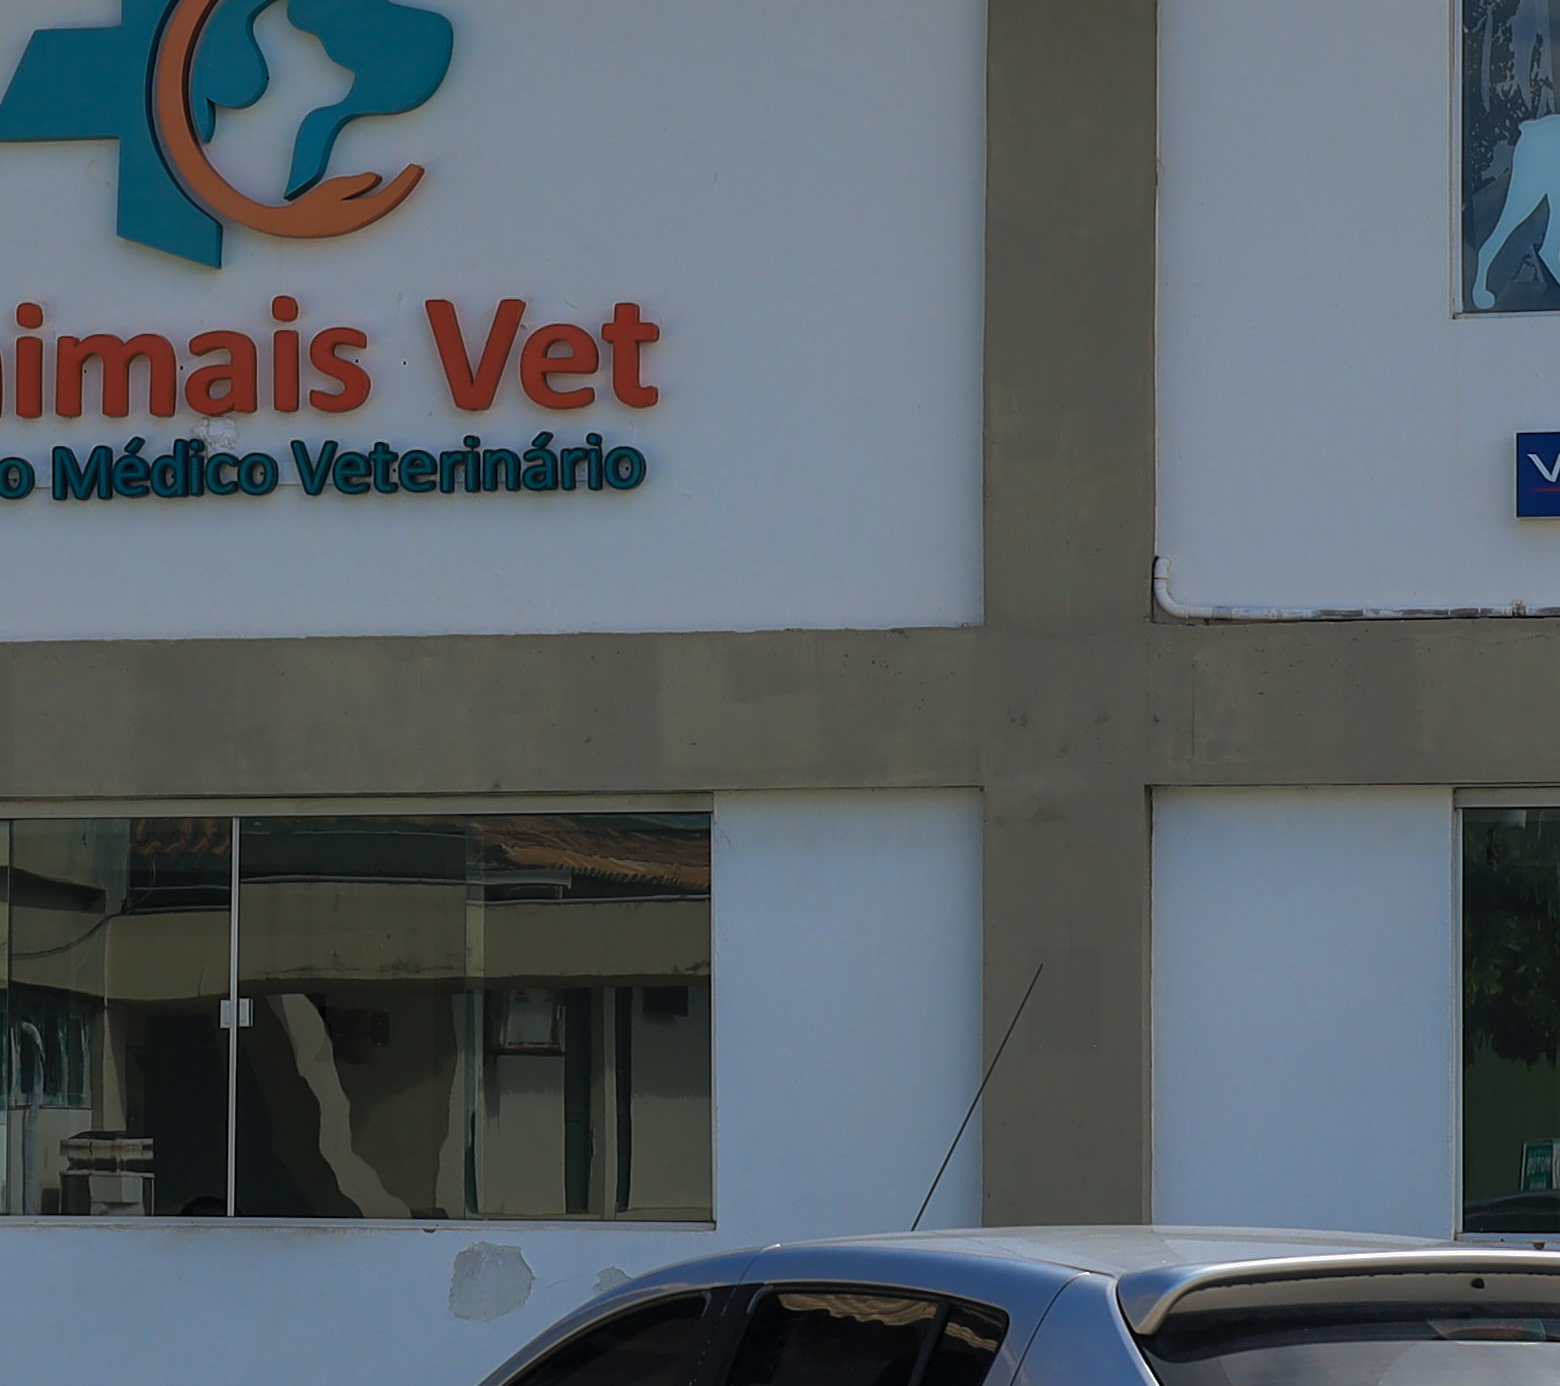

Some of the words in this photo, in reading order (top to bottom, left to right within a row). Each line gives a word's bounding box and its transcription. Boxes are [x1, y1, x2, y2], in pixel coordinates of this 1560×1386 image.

[425, 298, 661, 411] Vet
[51, 436, 279, 501] Médico
[291, 431, 647, 497] Veterinário
